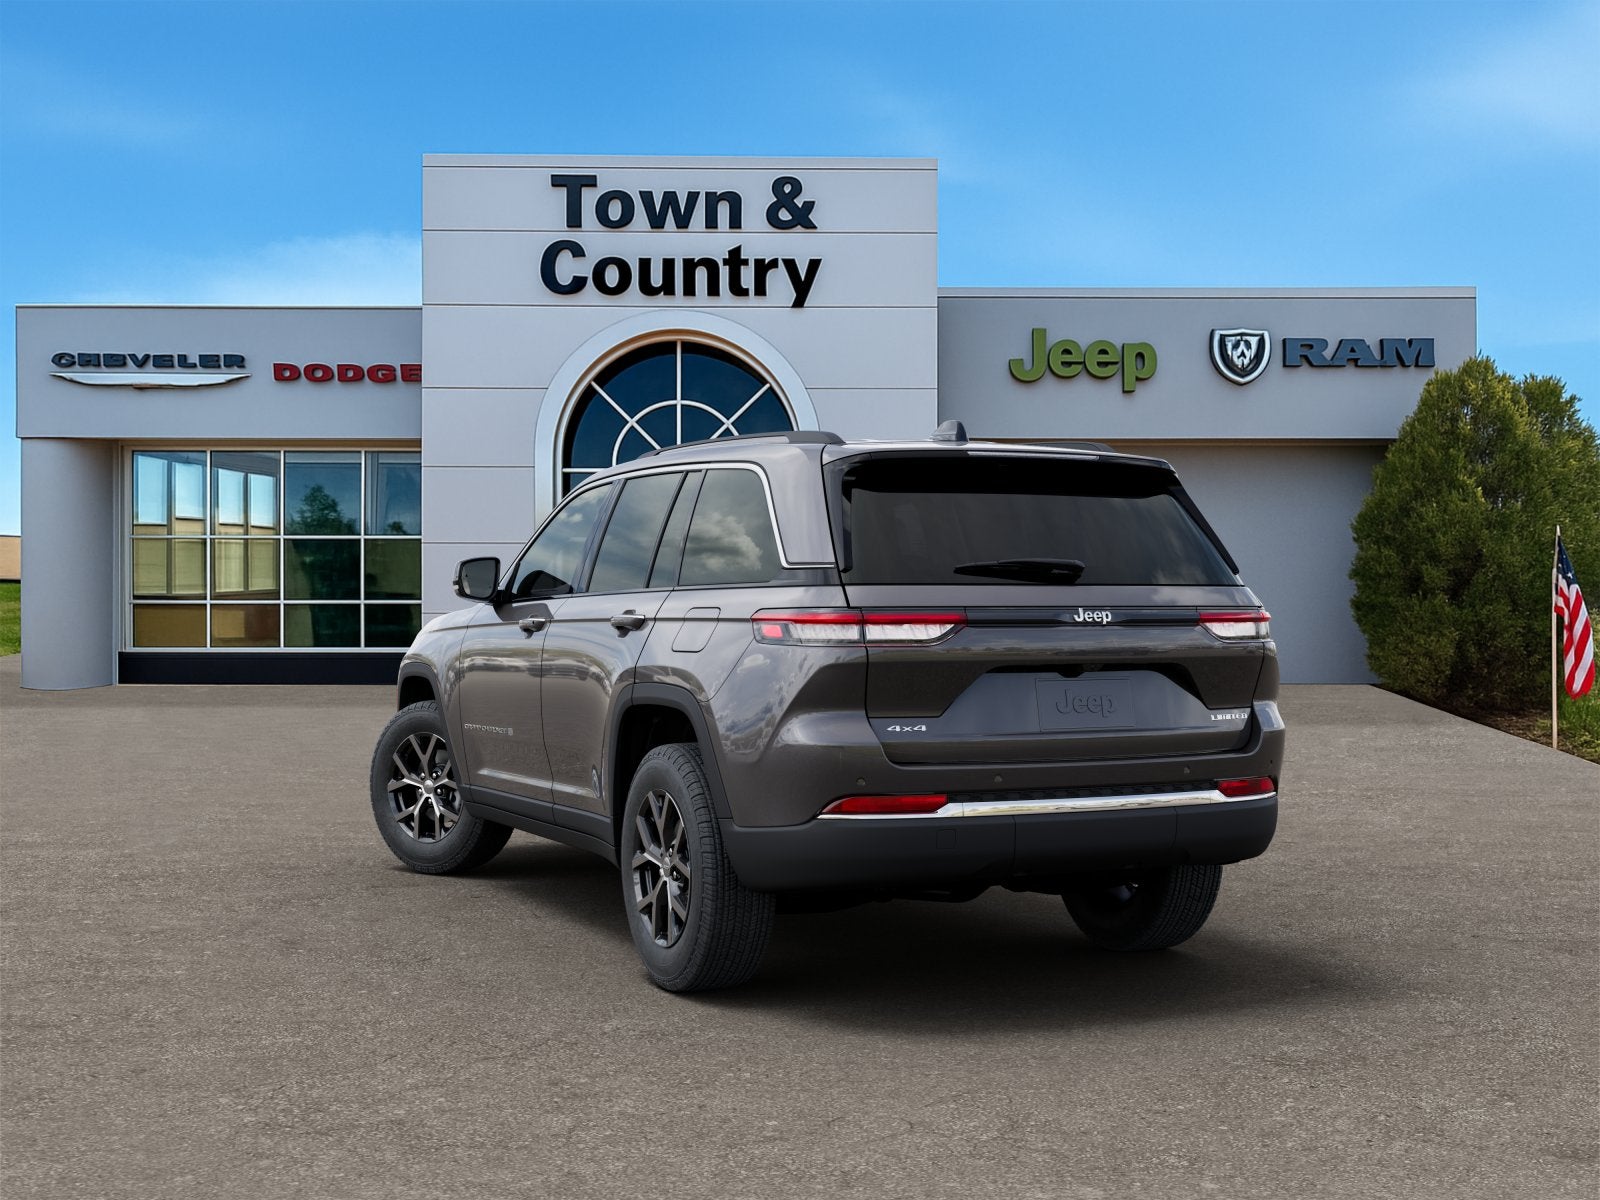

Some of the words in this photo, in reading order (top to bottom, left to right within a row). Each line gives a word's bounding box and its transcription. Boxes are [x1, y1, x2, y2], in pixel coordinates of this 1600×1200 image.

[550, 174, 743, 229] Town
[765, 175, 818, 230] &
[540, 239, 823, 308] Country
[1009, 328, 1158, 393] Jeep
[1283, 337, 1436, 368] RAM
[273, 363, 422, 384] DODGE
[1073, 607, 1112, 625] Jeep
[1055, 688, 1117, 718] Jeep
